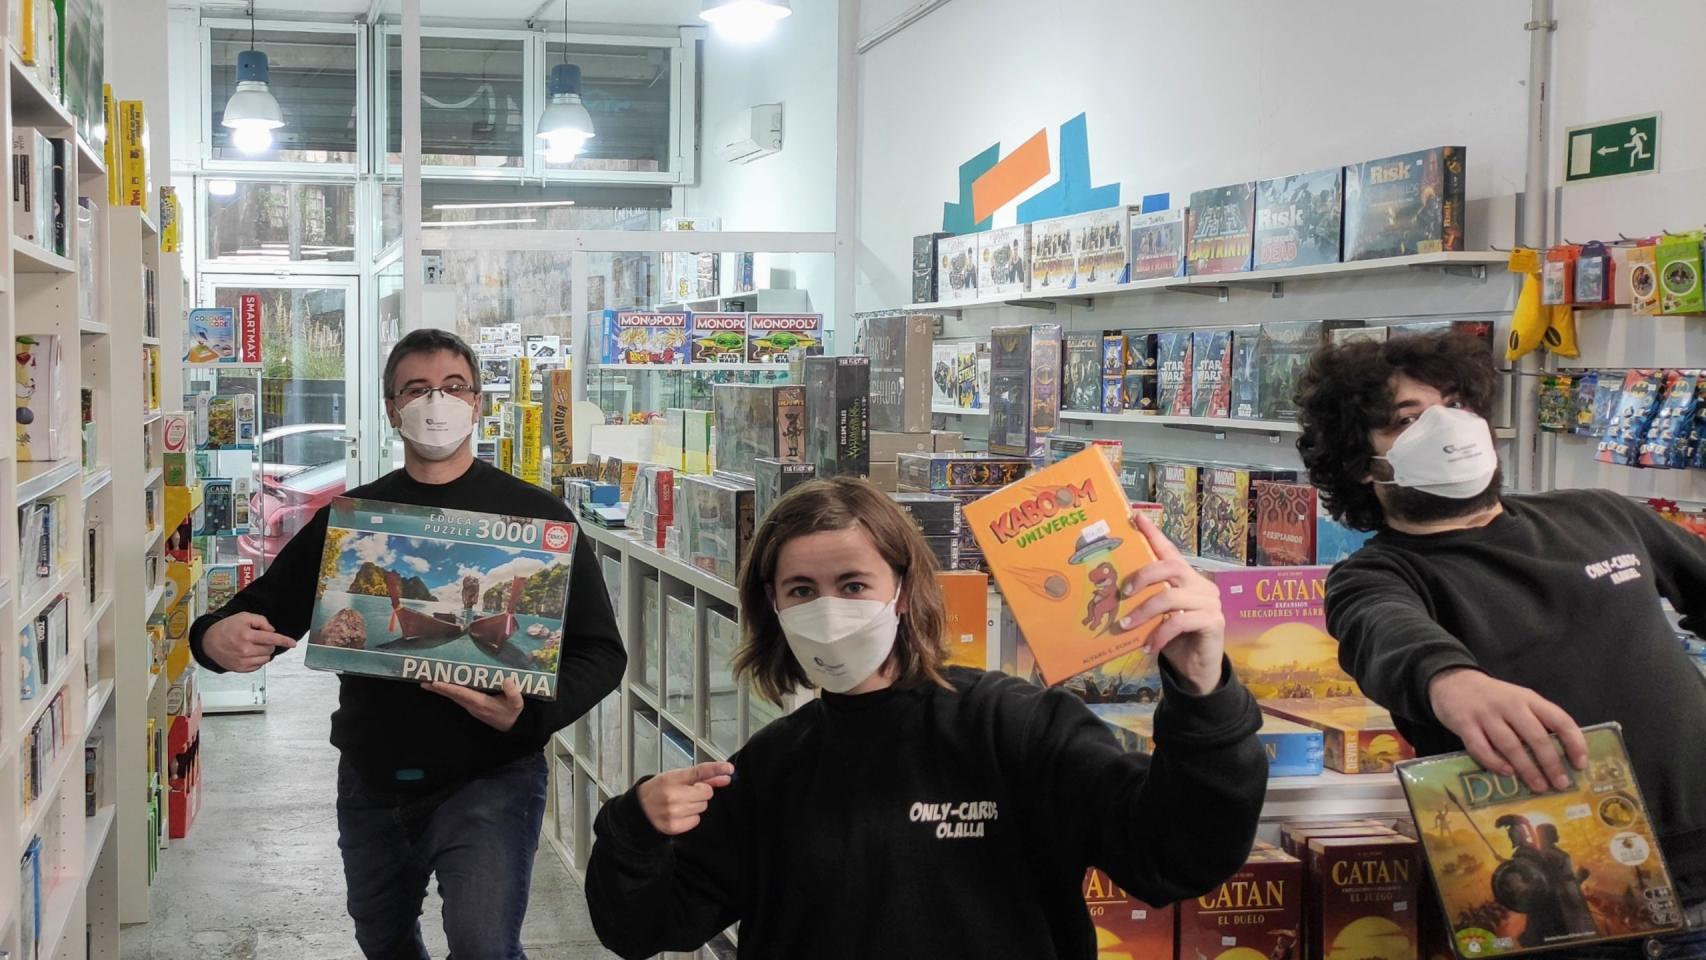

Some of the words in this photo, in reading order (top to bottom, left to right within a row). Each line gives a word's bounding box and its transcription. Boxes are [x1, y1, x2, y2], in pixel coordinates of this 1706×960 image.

[246, 296, 256, 358] SMARTMAX
[620, 314, 685, 327] MONOPOLY
[752, 317, 818, 330] MONOPOLY
[1161, 360, 1185, 371] STAR
[1197, 359, 1222, 370] STAR
[1161, 371, 1185, 381] WARS
[1197, 370, 1222, 381] WARS
[554, 404, 569, 449] KARUBA
[989, 478, 1097, 544] KABOOM
[429, 513, 472, 526] EDUCA
[424, 523, 472, 537] PUZZLE
[475, 519, 537, 545] 3000
[1016, 509, 1088, 549] UNIVERSE
[1256, 579, 1325, 602] CATAN
[1240, 609, 1293, 618] MERCADERES
[1295, 609, 1300, 617] Y
[402, 658, 551, 697] PANORAMA
[936, 822, 985, 839] OLALLA
[1331, 859, 1409, 887] CATAN
[1351, 893, 1362, 903] EL
[1365, 892, 1393, 902] JUEGO
[1218, 916, 1230, 926] EL
[1234, 914, 1265, 925] DUELO
